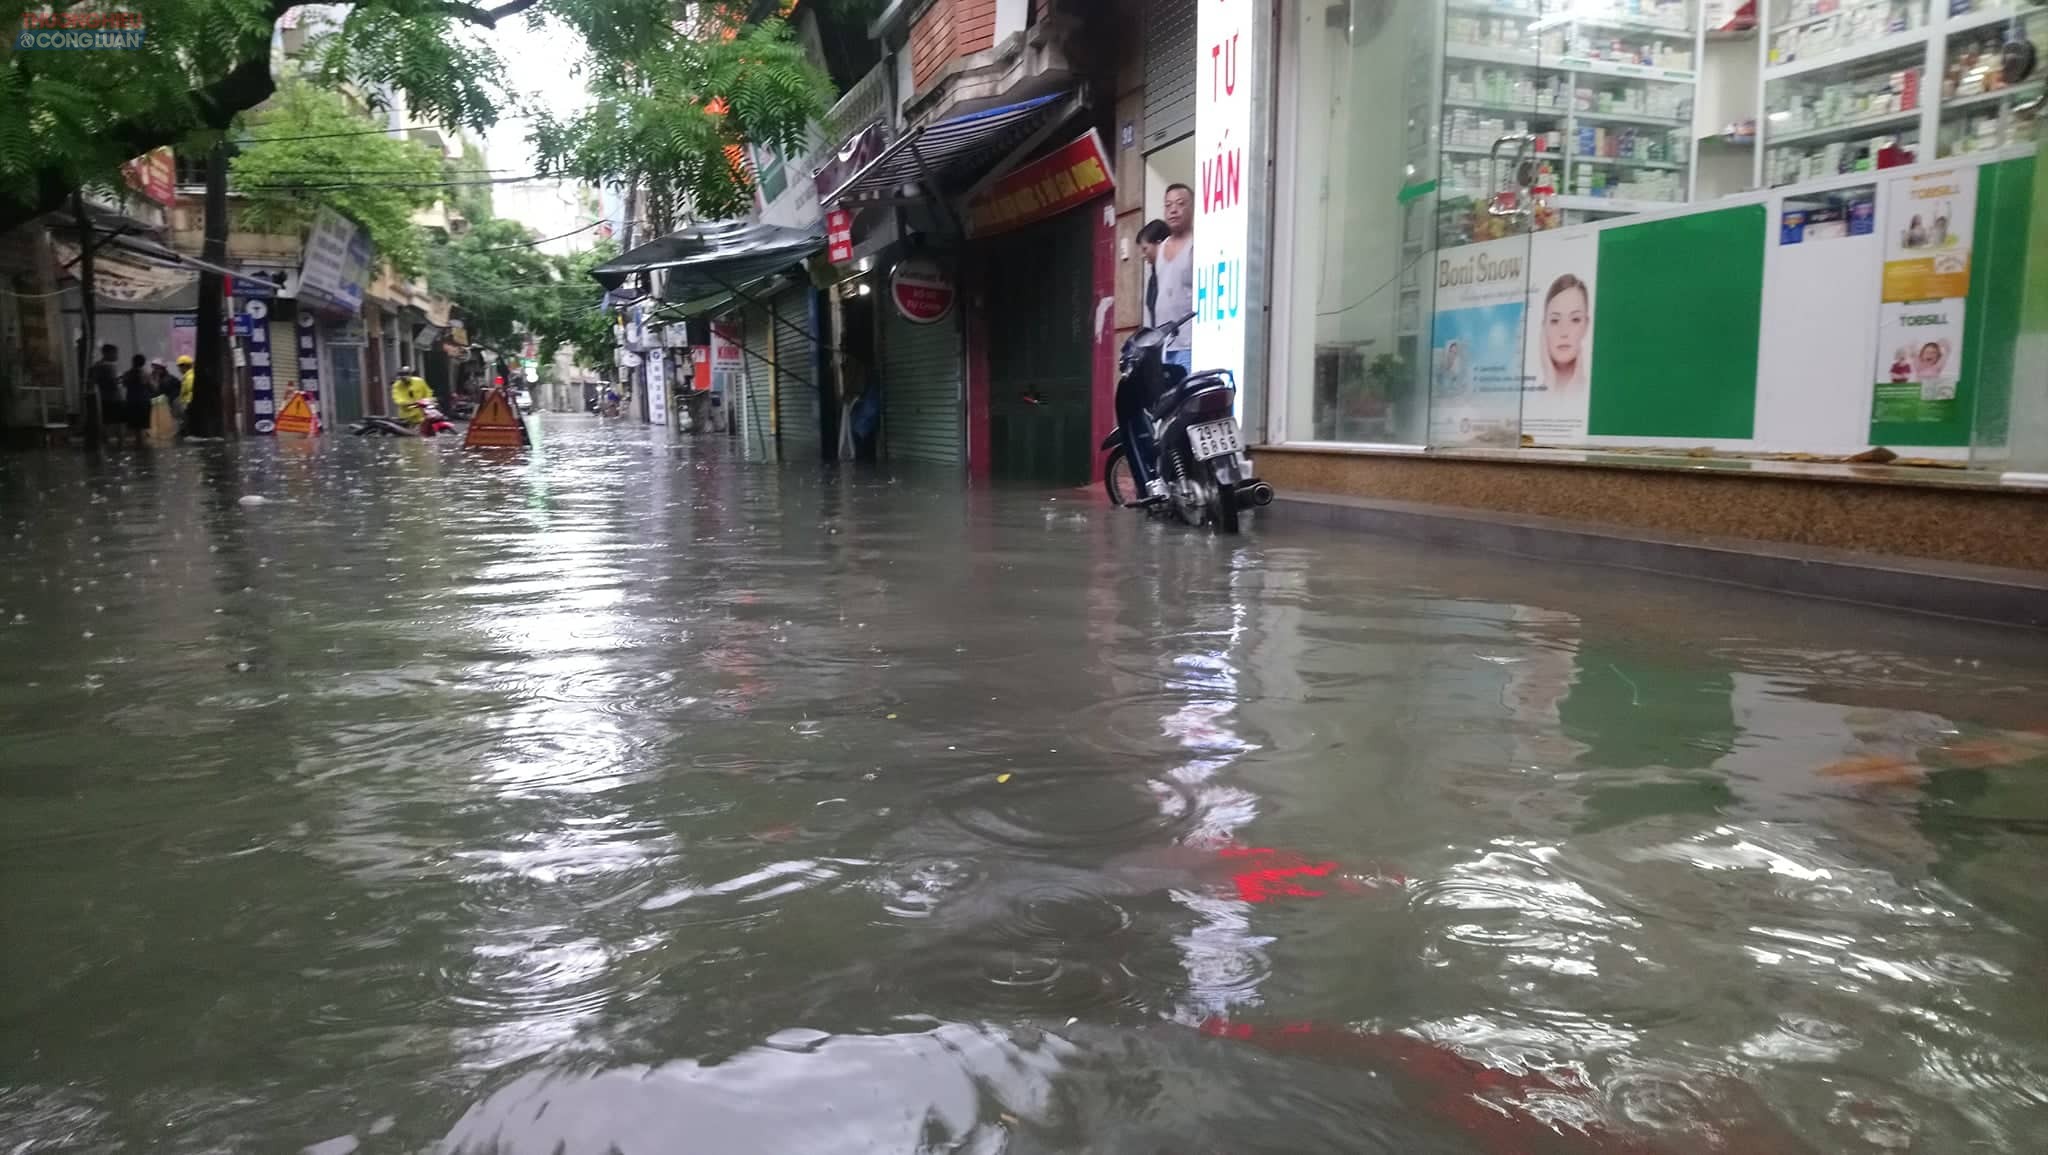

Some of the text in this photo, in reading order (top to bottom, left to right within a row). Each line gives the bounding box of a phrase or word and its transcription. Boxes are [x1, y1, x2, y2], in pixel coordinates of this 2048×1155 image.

[1211, 28, 1240, 103] TƯ
[1202, 128, 1241, 216] VẤN
[1197, 250, 1241, 331] HIỆU
[1438, 251, 1523, 289] Boni Snow
